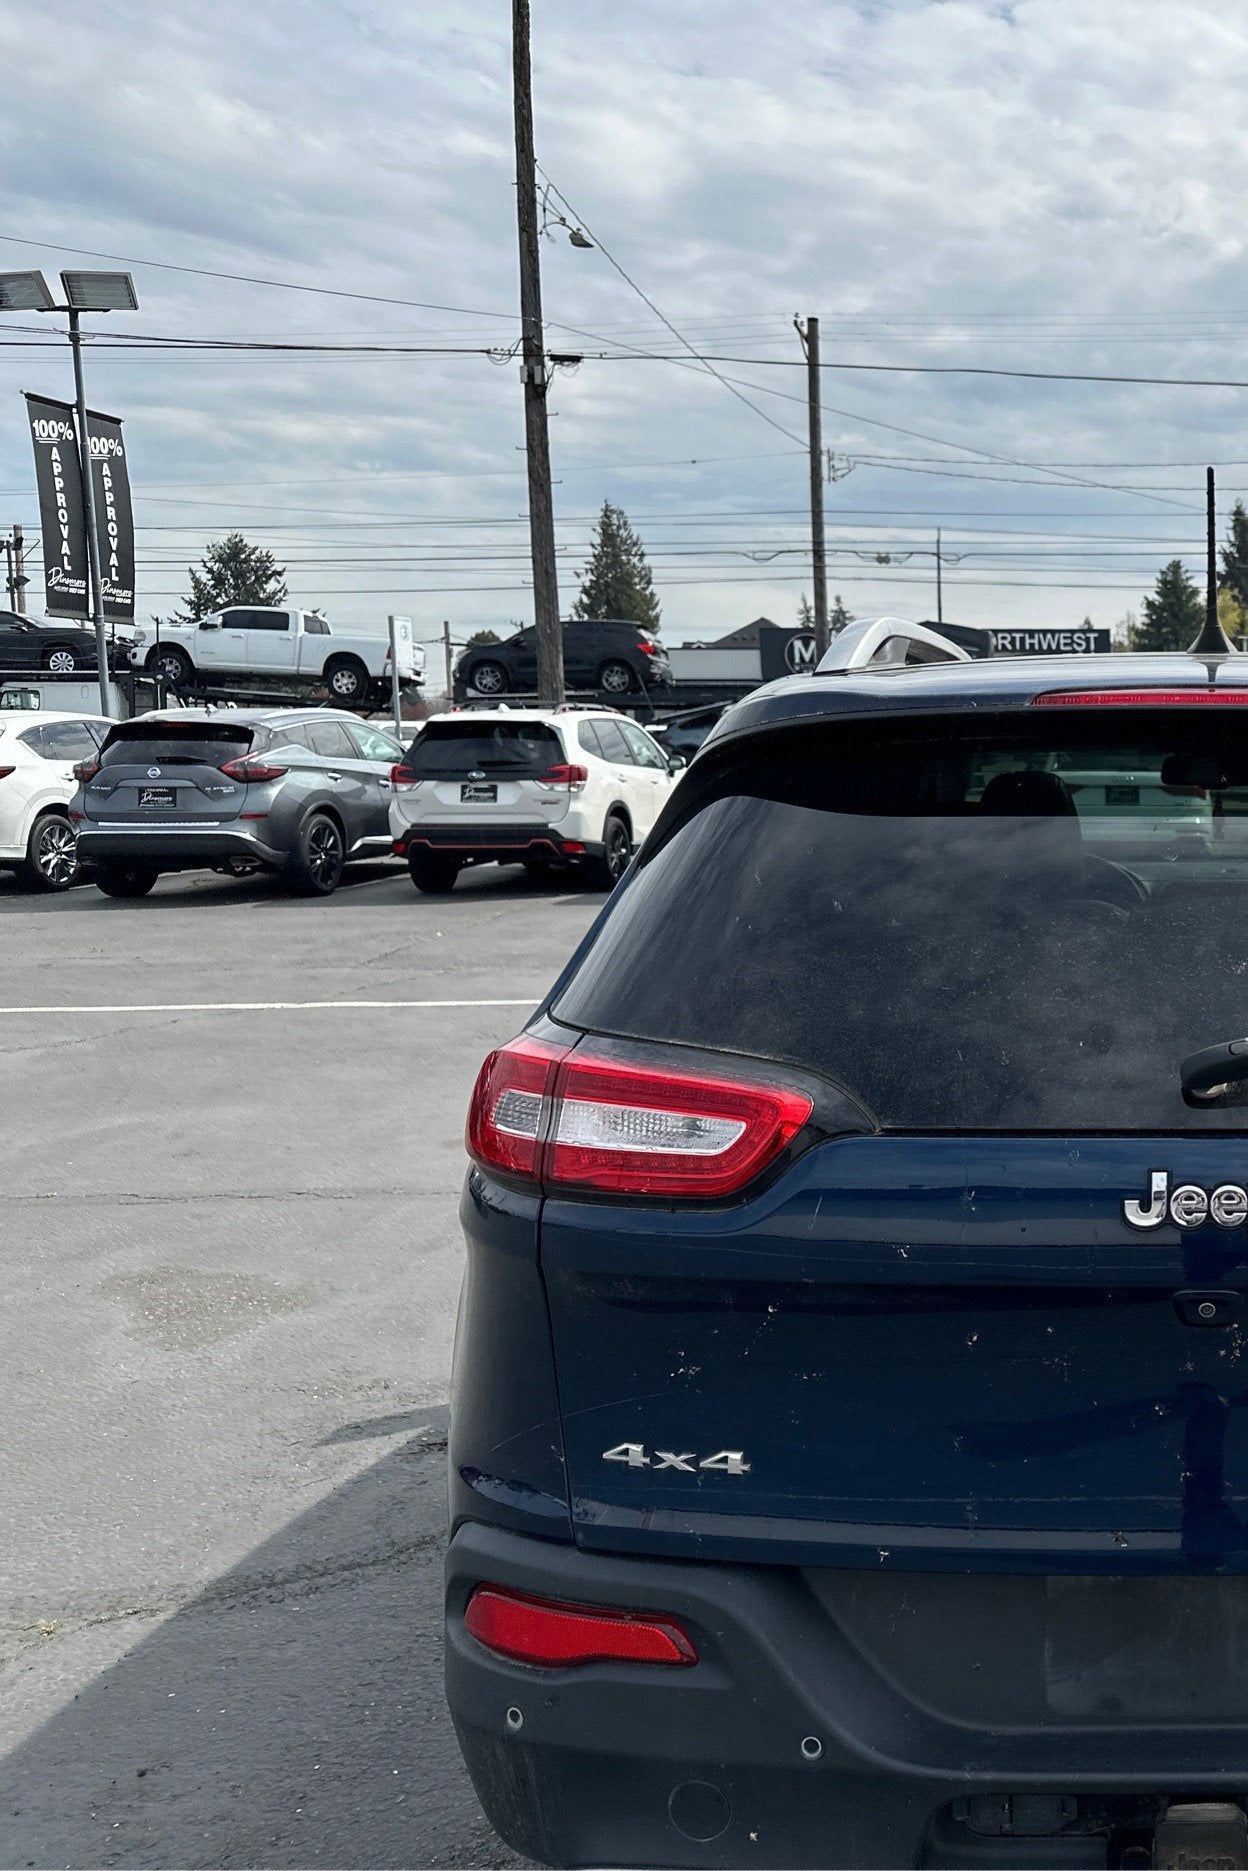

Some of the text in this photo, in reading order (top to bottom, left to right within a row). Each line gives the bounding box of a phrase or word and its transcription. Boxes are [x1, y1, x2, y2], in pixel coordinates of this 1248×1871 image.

[32, 419, 74, 440] 100%
[51, 446, 72, 571] APPROVAL
[102, 462, 120, 582] APPROVAL
[993, 631, 1099, 653] RTHWEST
[602, 1442, 751, 1476] 4x4
